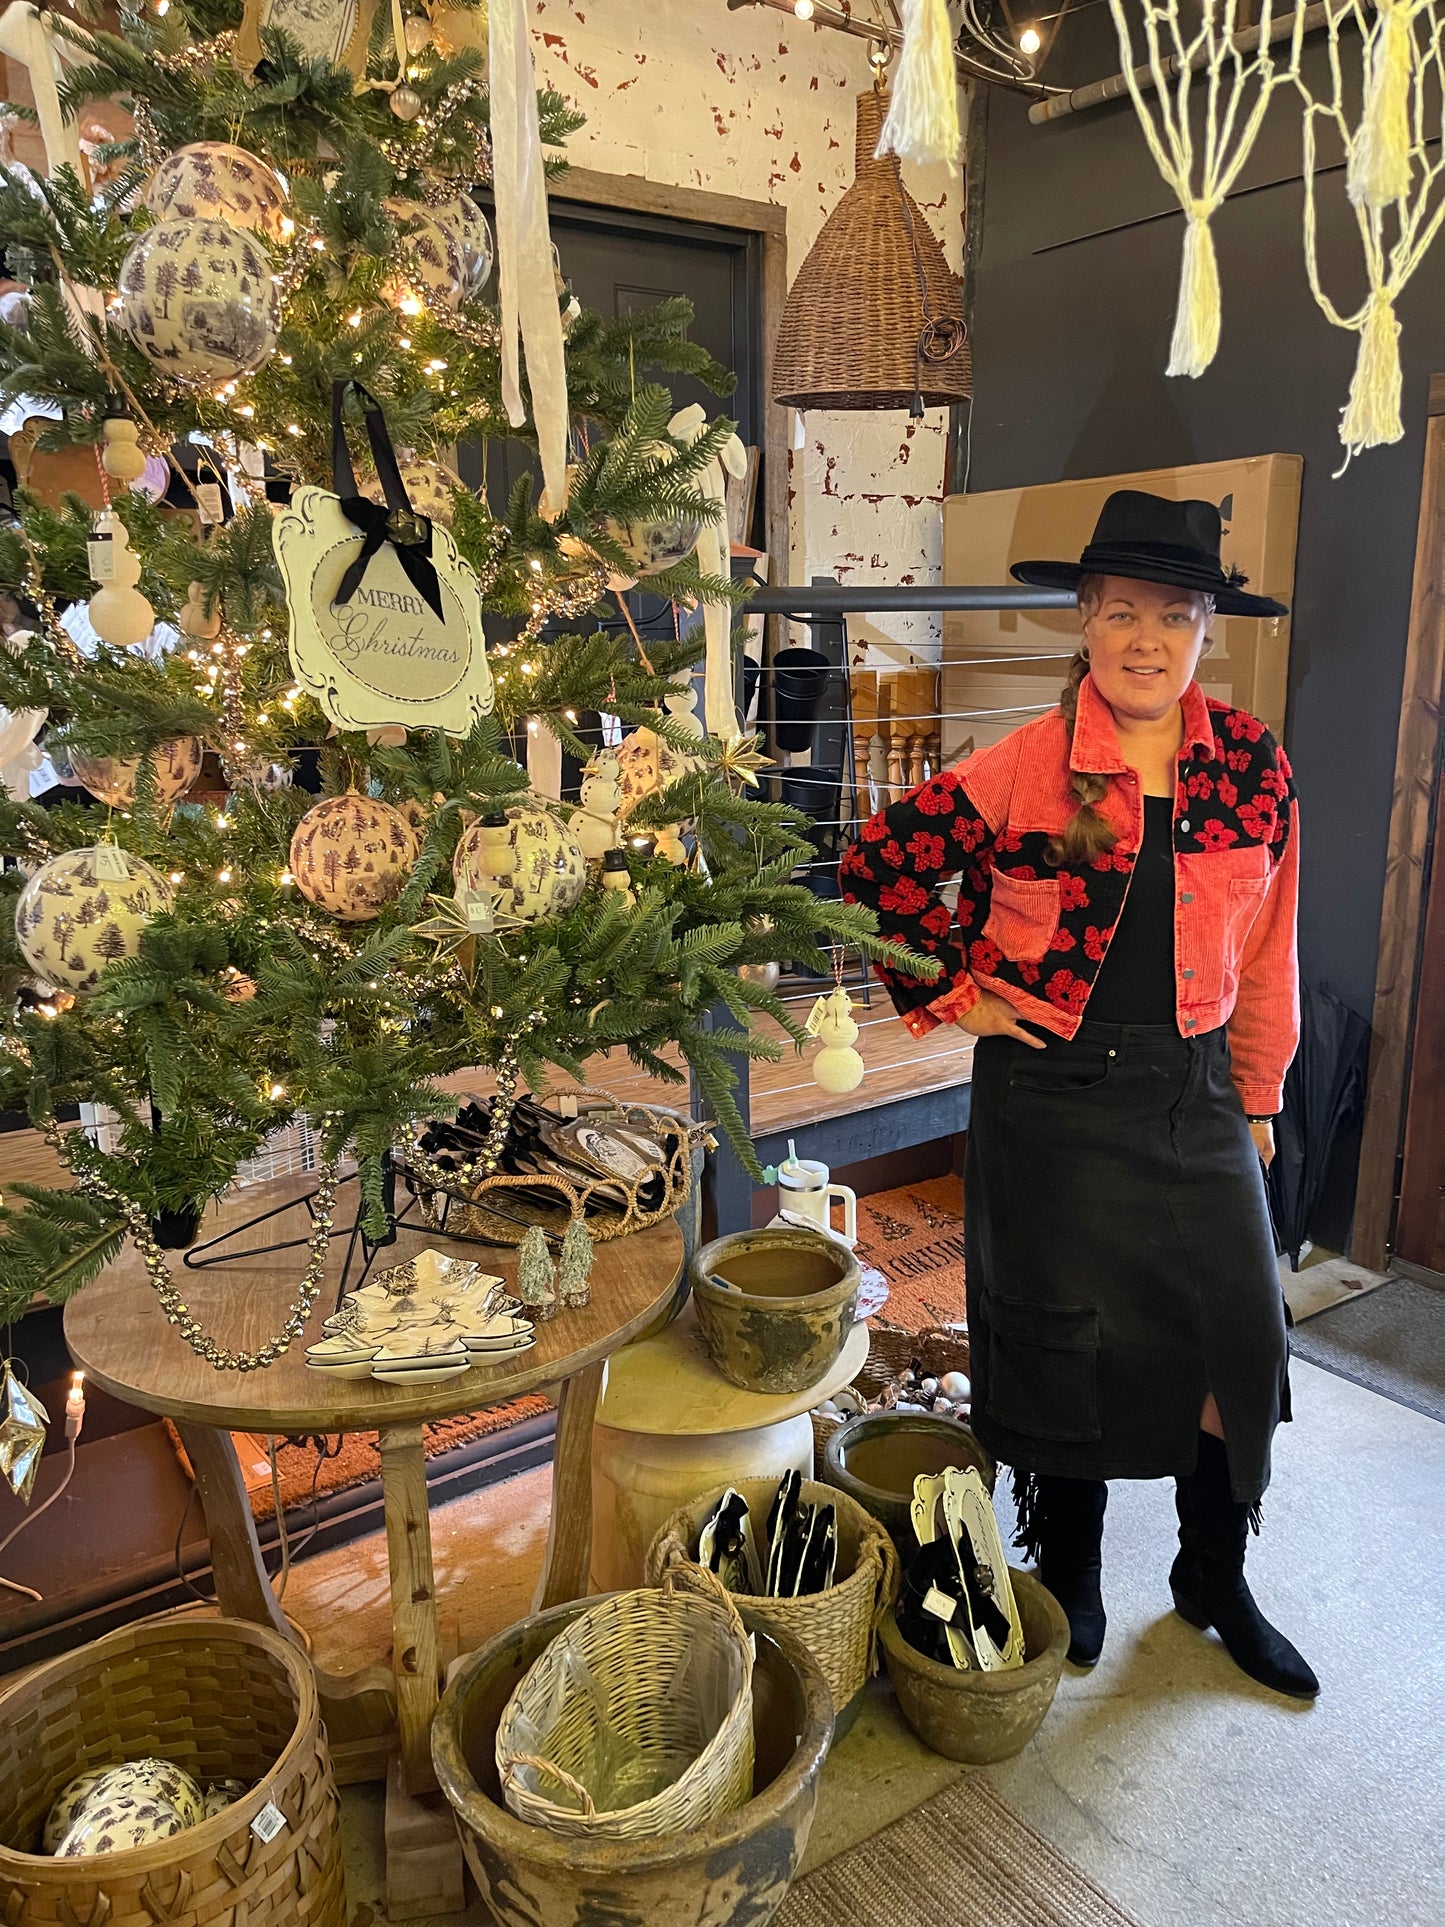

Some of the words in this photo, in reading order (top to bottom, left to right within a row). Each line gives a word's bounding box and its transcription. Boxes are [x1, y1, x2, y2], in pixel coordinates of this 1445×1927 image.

[357, 587, 425, 616] MERRY
[329, 601, 460, 663] Christmas
[888, 1233, 966, 1278] CHRISTM
